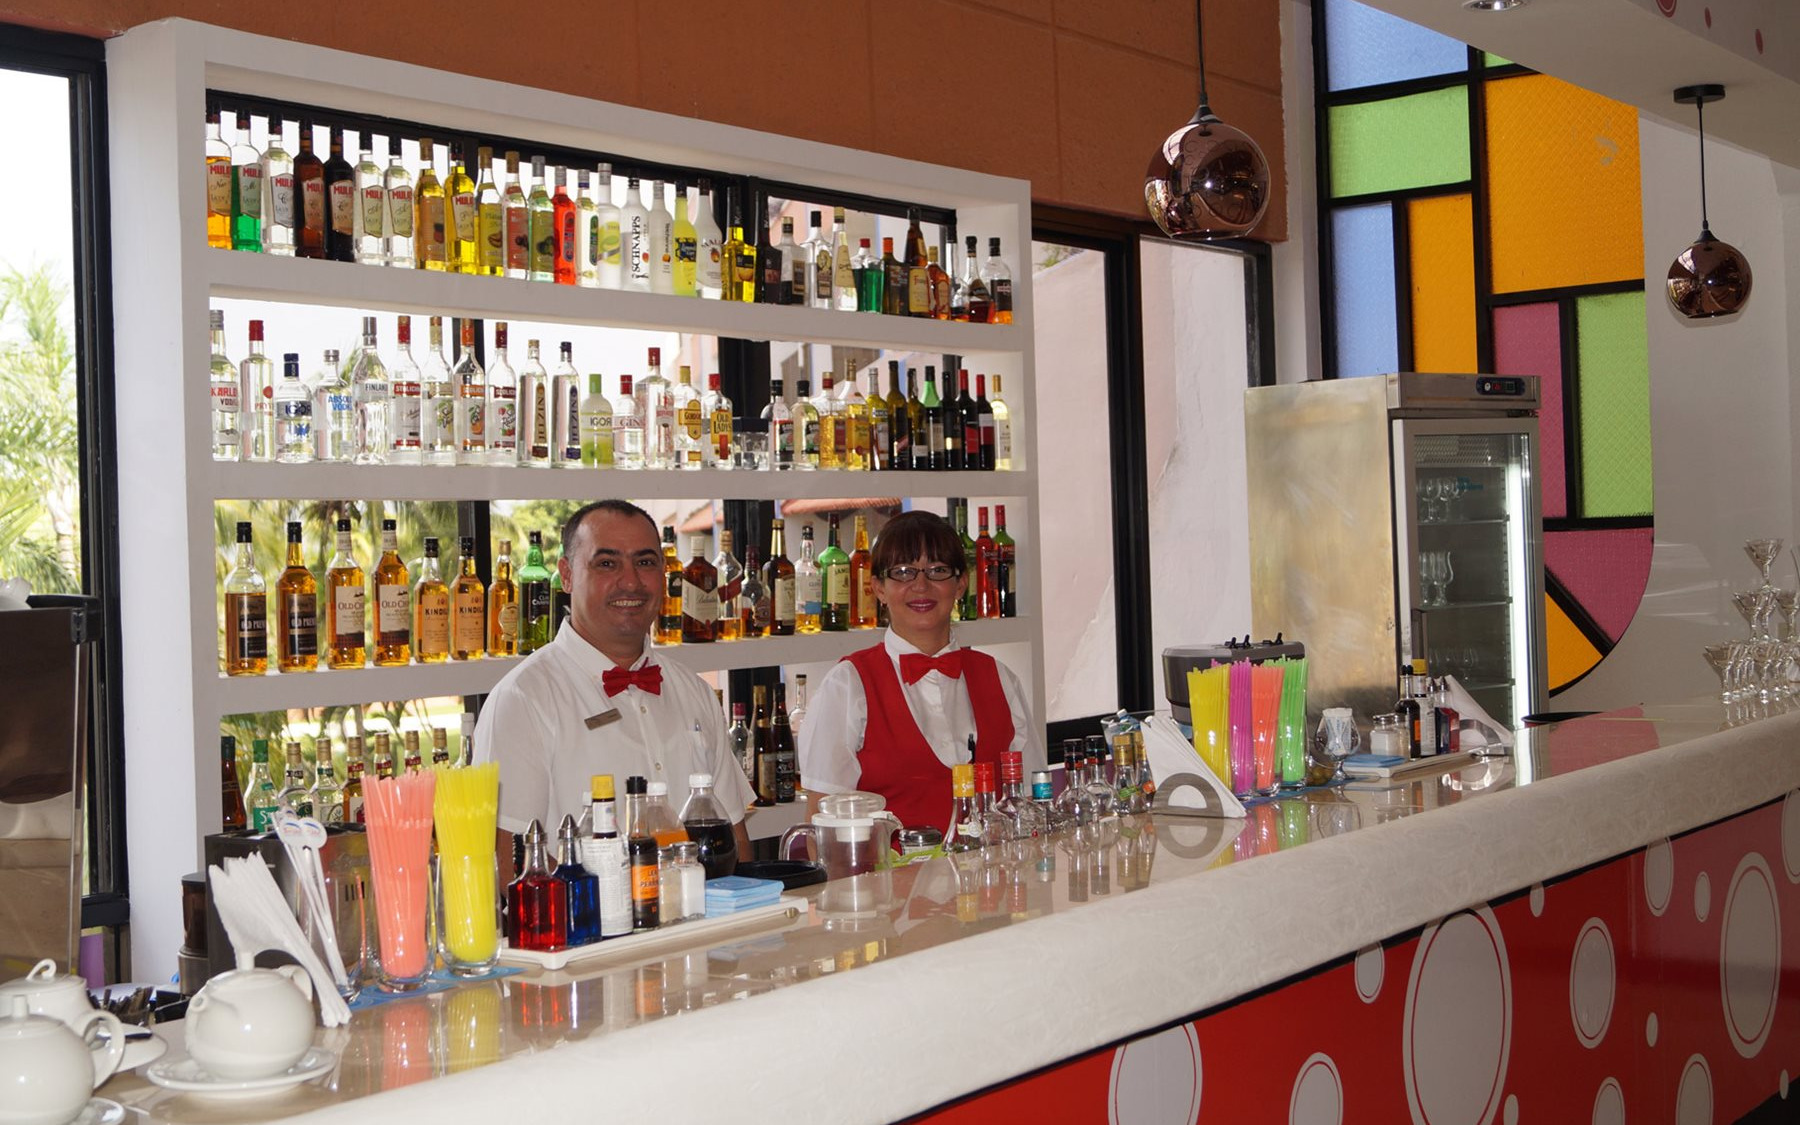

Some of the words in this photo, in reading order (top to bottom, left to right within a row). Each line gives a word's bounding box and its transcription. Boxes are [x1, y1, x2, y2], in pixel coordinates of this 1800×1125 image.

[631, 215, 641, 273] SCHNAPPS
[620, 418, 641, 427] GIN
[338, 602, 354, 611] OLD
[381, 601, 397, 609] OLD
